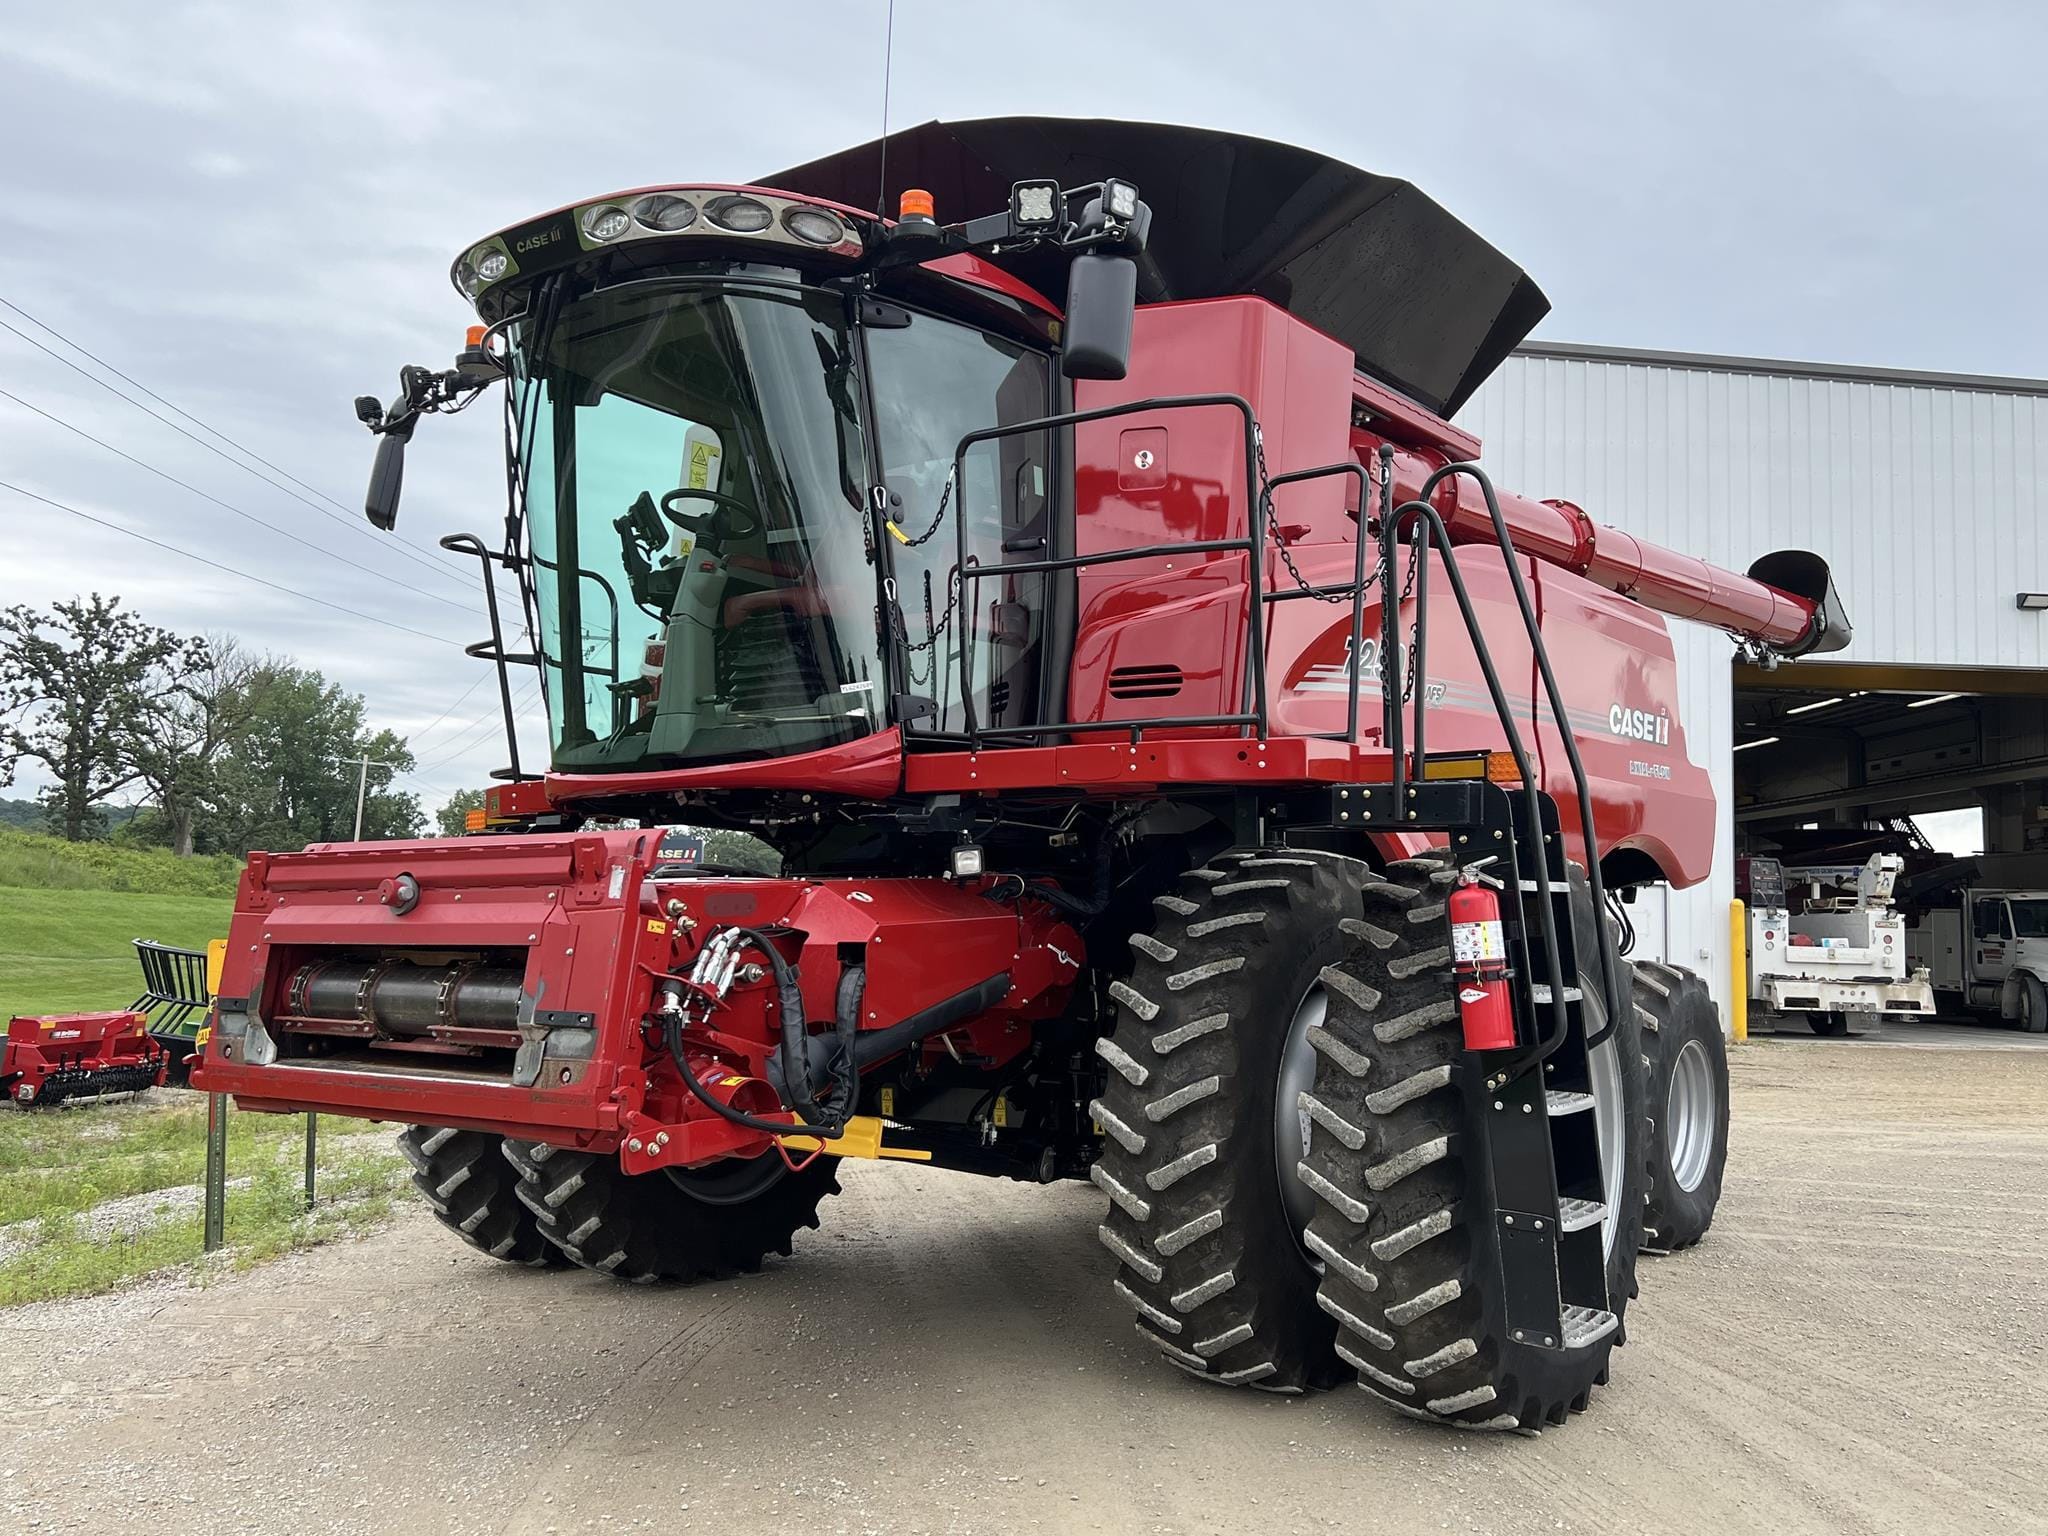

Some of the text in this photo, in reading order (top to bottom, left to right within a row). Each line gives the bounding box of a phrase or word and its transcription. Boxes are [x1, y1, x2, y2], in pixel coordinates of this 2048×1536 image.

[516, 234, 549, 253] CASE
[1609, 703, 1655, 742] CASE
[657, 849, 683, 858] ASE
